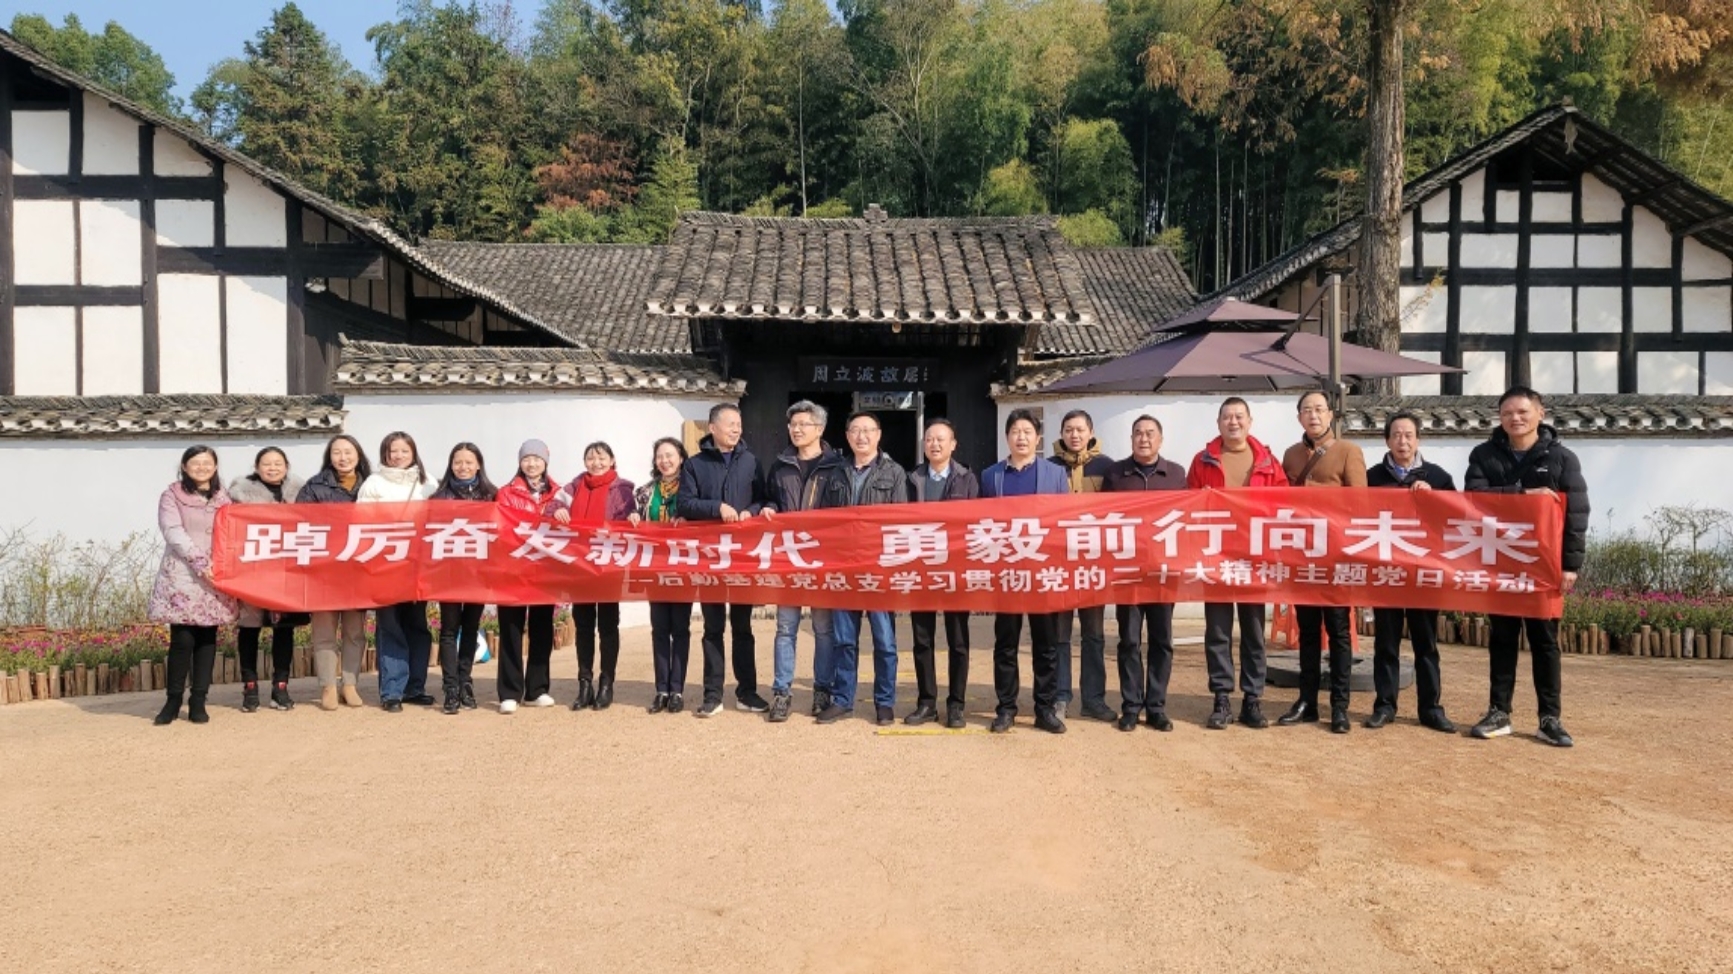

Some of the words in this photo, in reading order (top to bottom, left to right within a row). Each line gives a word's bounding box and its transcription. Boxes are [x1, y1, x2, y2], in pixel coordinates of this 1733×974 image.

[812, 364, 919, 383] 周立波故居
[240, 517, 824, 569] 踔厉奋发新时代
[878, 509, 1540, 567] 勇毅前行向未来
